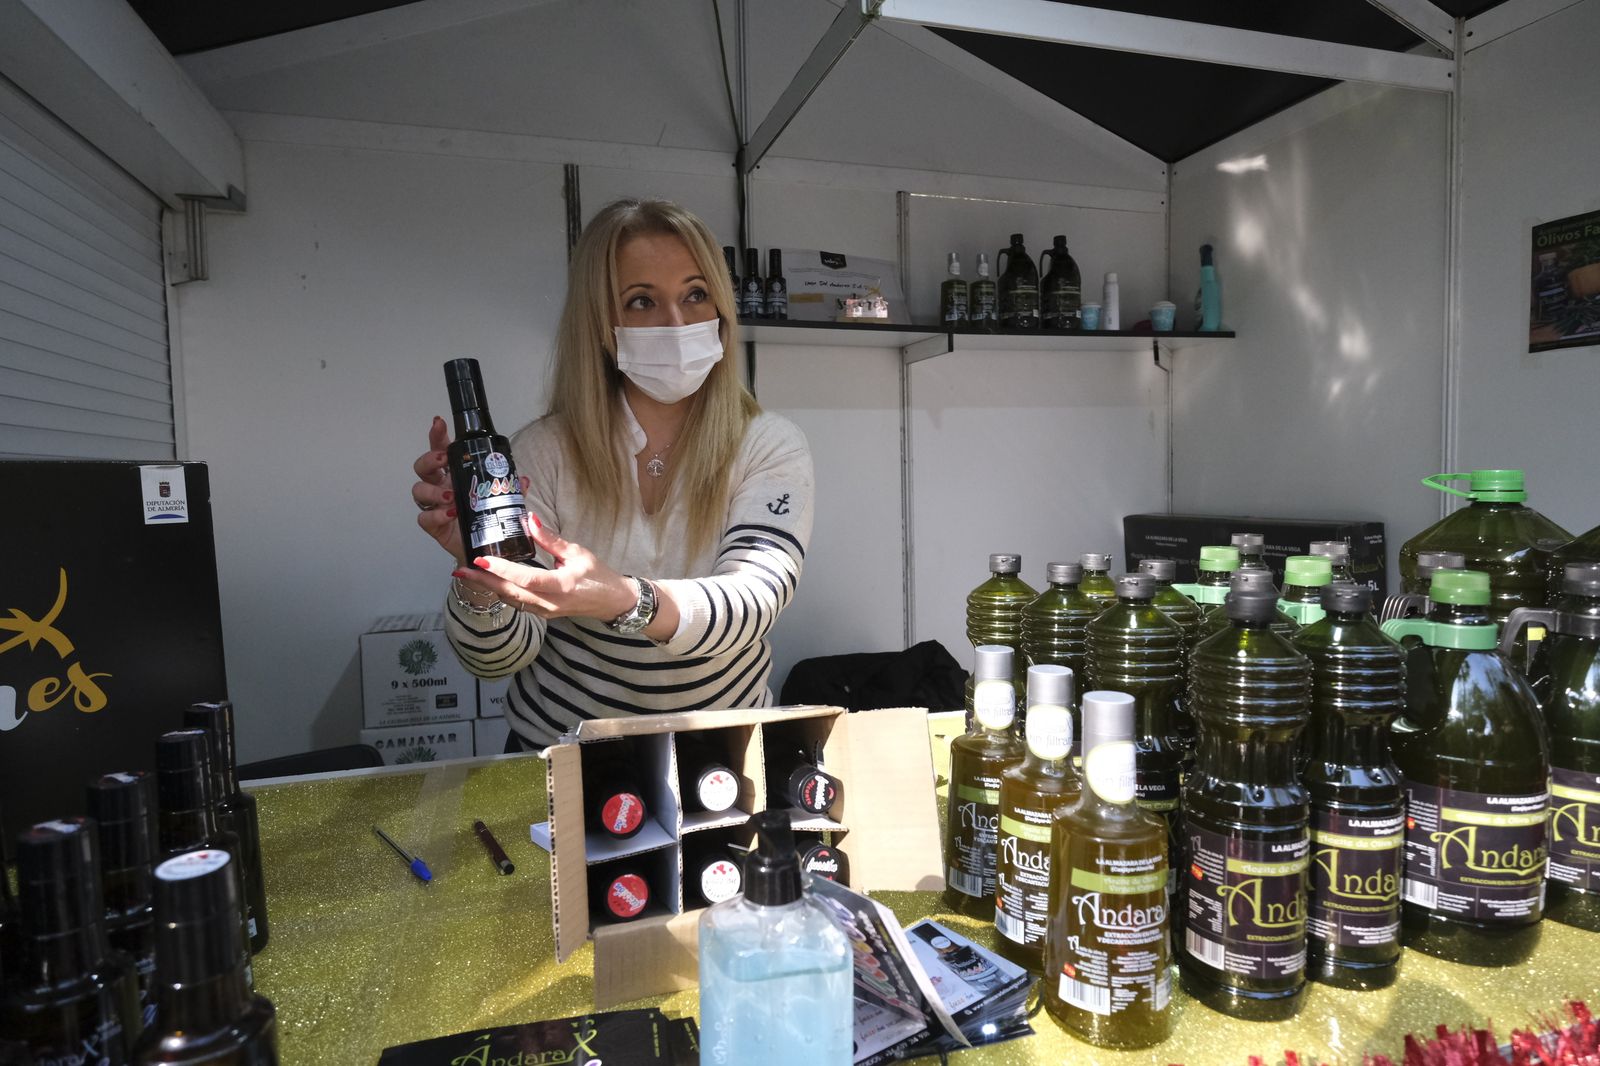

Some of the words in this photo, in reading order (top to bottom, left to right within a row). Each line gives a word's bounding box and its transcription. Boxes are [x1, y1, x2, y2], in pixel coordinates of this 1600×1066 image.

[1537, 230, 1581, 247] Olivos
[391, 679, 399, 689] 9
[412, 677, 447, 688] 500ml
